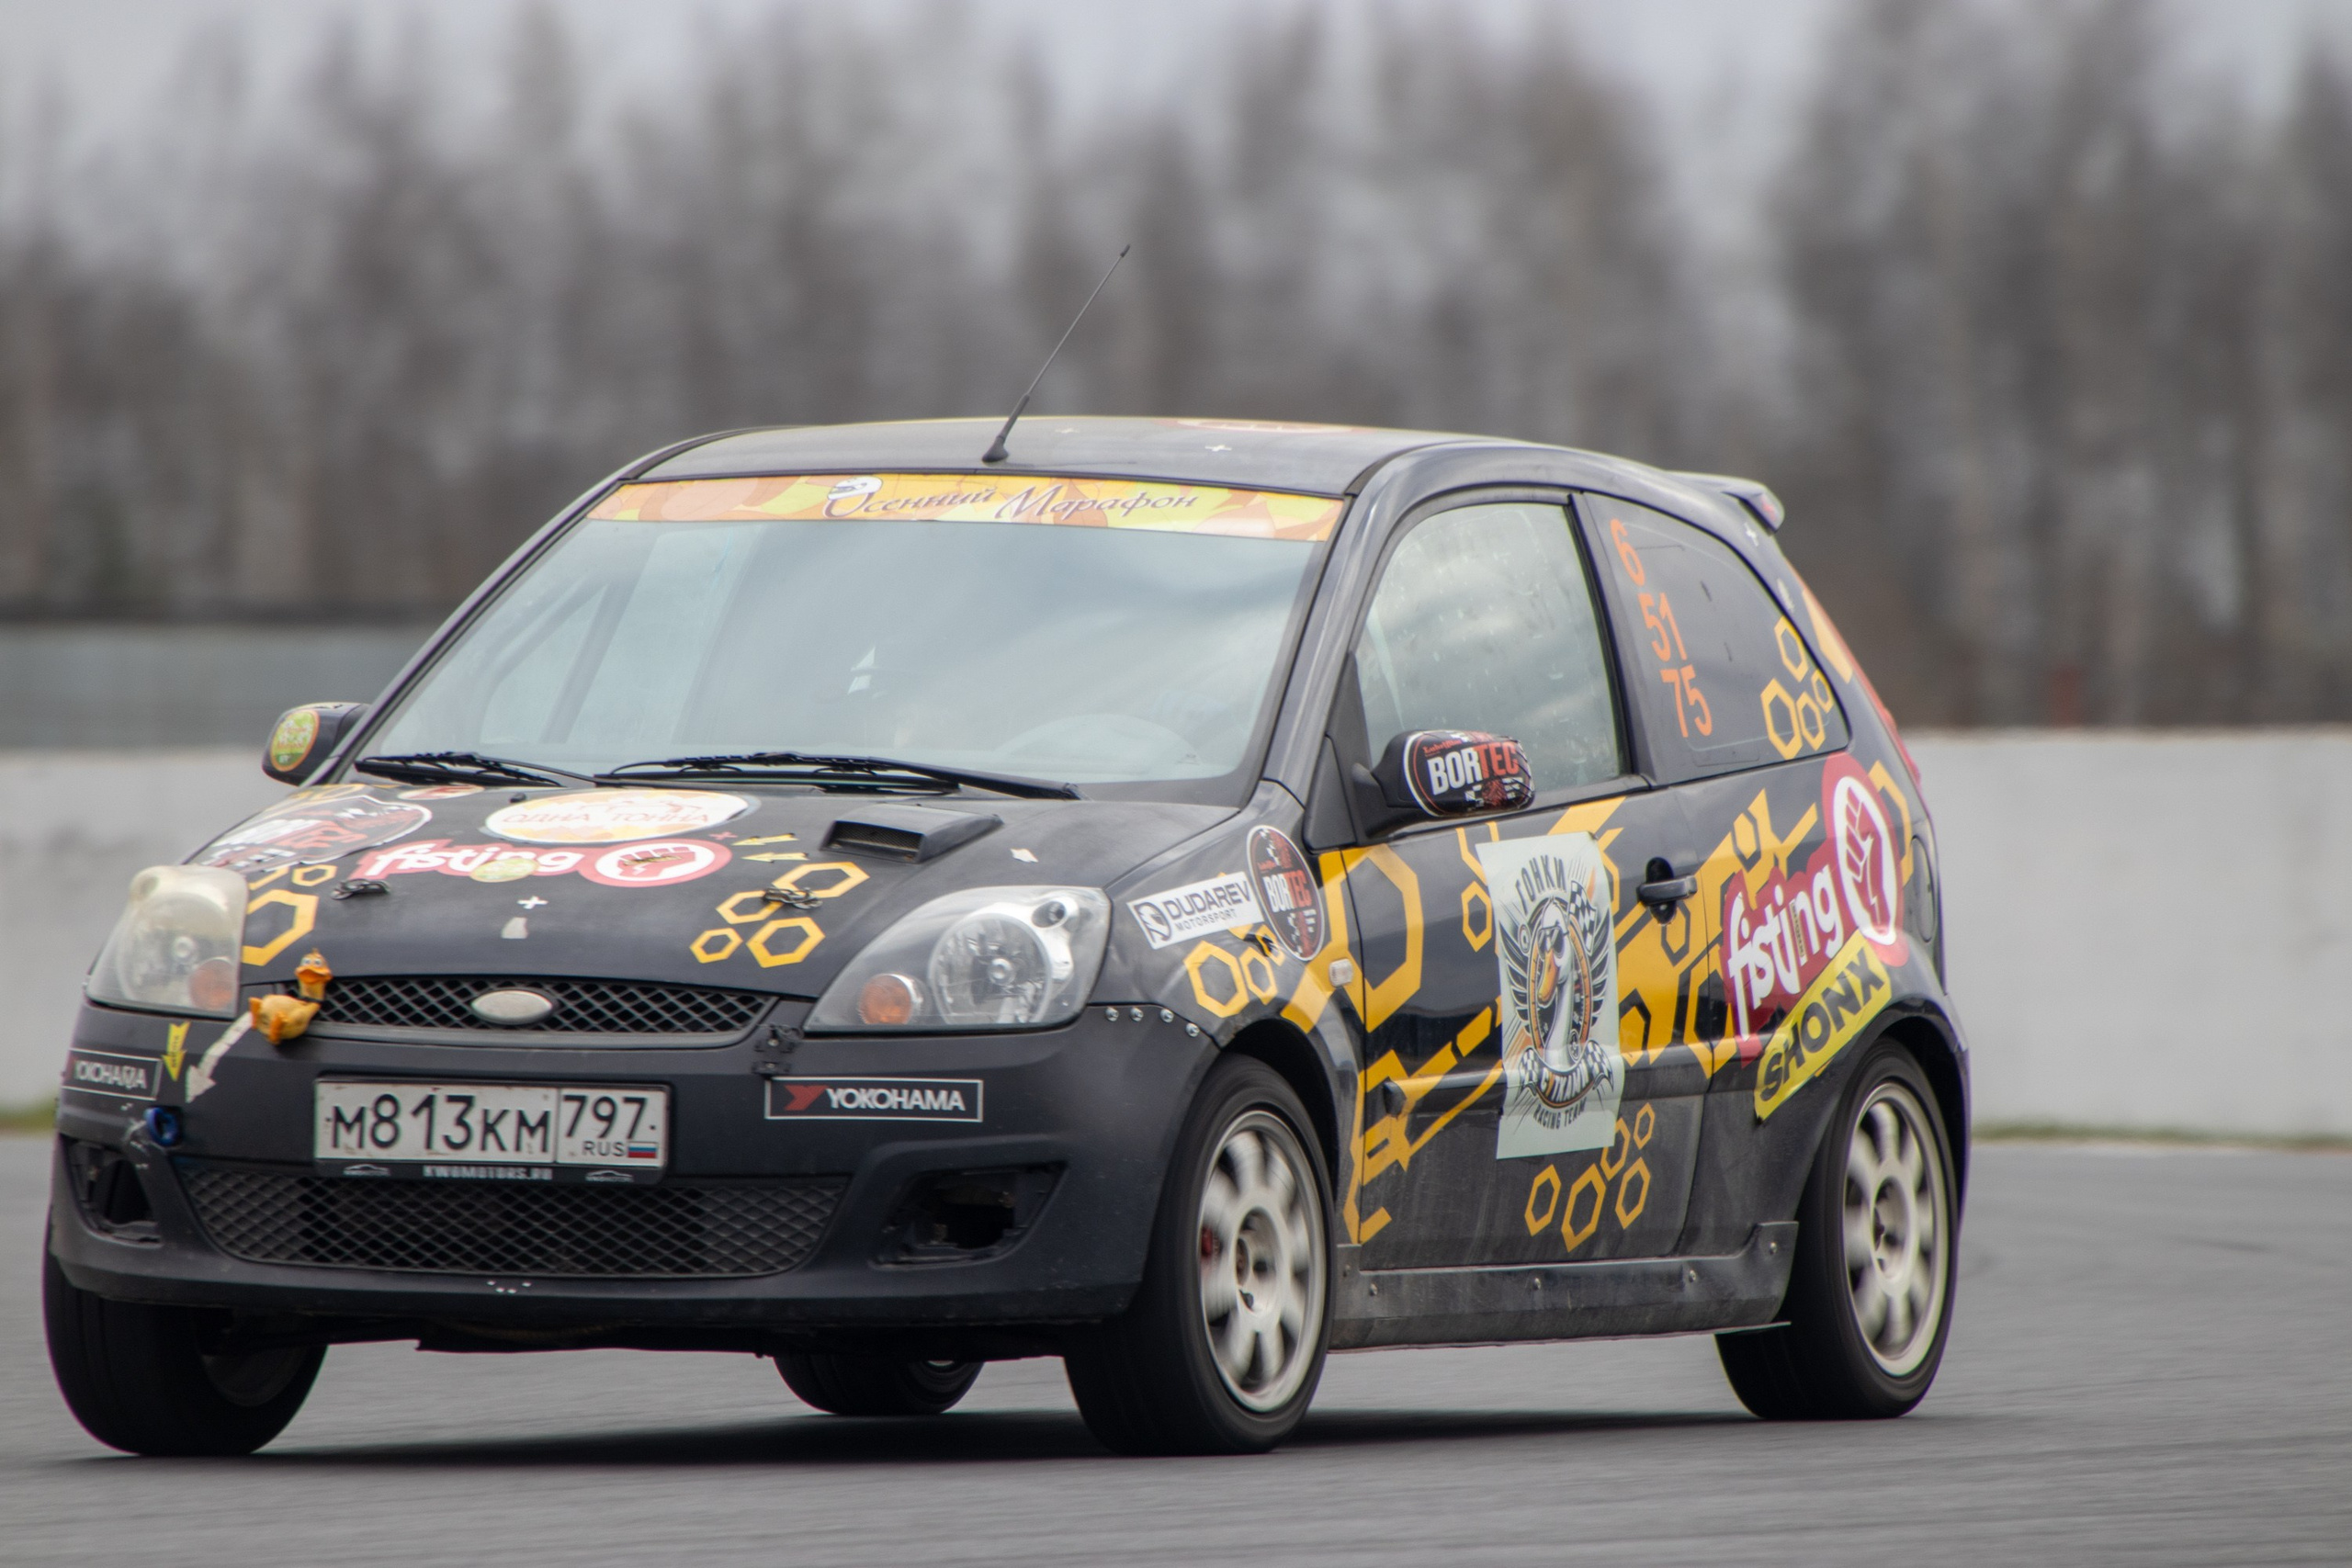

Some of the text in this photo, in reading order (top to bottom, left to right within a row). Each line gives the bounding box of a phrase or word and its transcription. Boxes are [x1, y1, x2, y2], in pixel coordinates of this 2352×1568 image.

[822, 485, 1200, 521] Осенний Марафон
[1611, 518, 1645, 586] 6
[1638, 592, 1687, 662] 51
[1660, 664, 1713, 738] 75
[1427, 741, 1520, 795] BORTEC
[1162, 881, 1250, 920] DUDAREV
[1515, 854, 1567, 917] ГОНКИ
[1175, 908, 1238, 931] MOTORSPORT
[1727, 864, 1846, 1042] fisting
[1759, 945, 1885, 1102] SHONX
[563, 1093, 648, 1140] 797
[827, 1088, 966, 1111] YOKOHAMA
[582, 1142, 627, 1158] RUS
